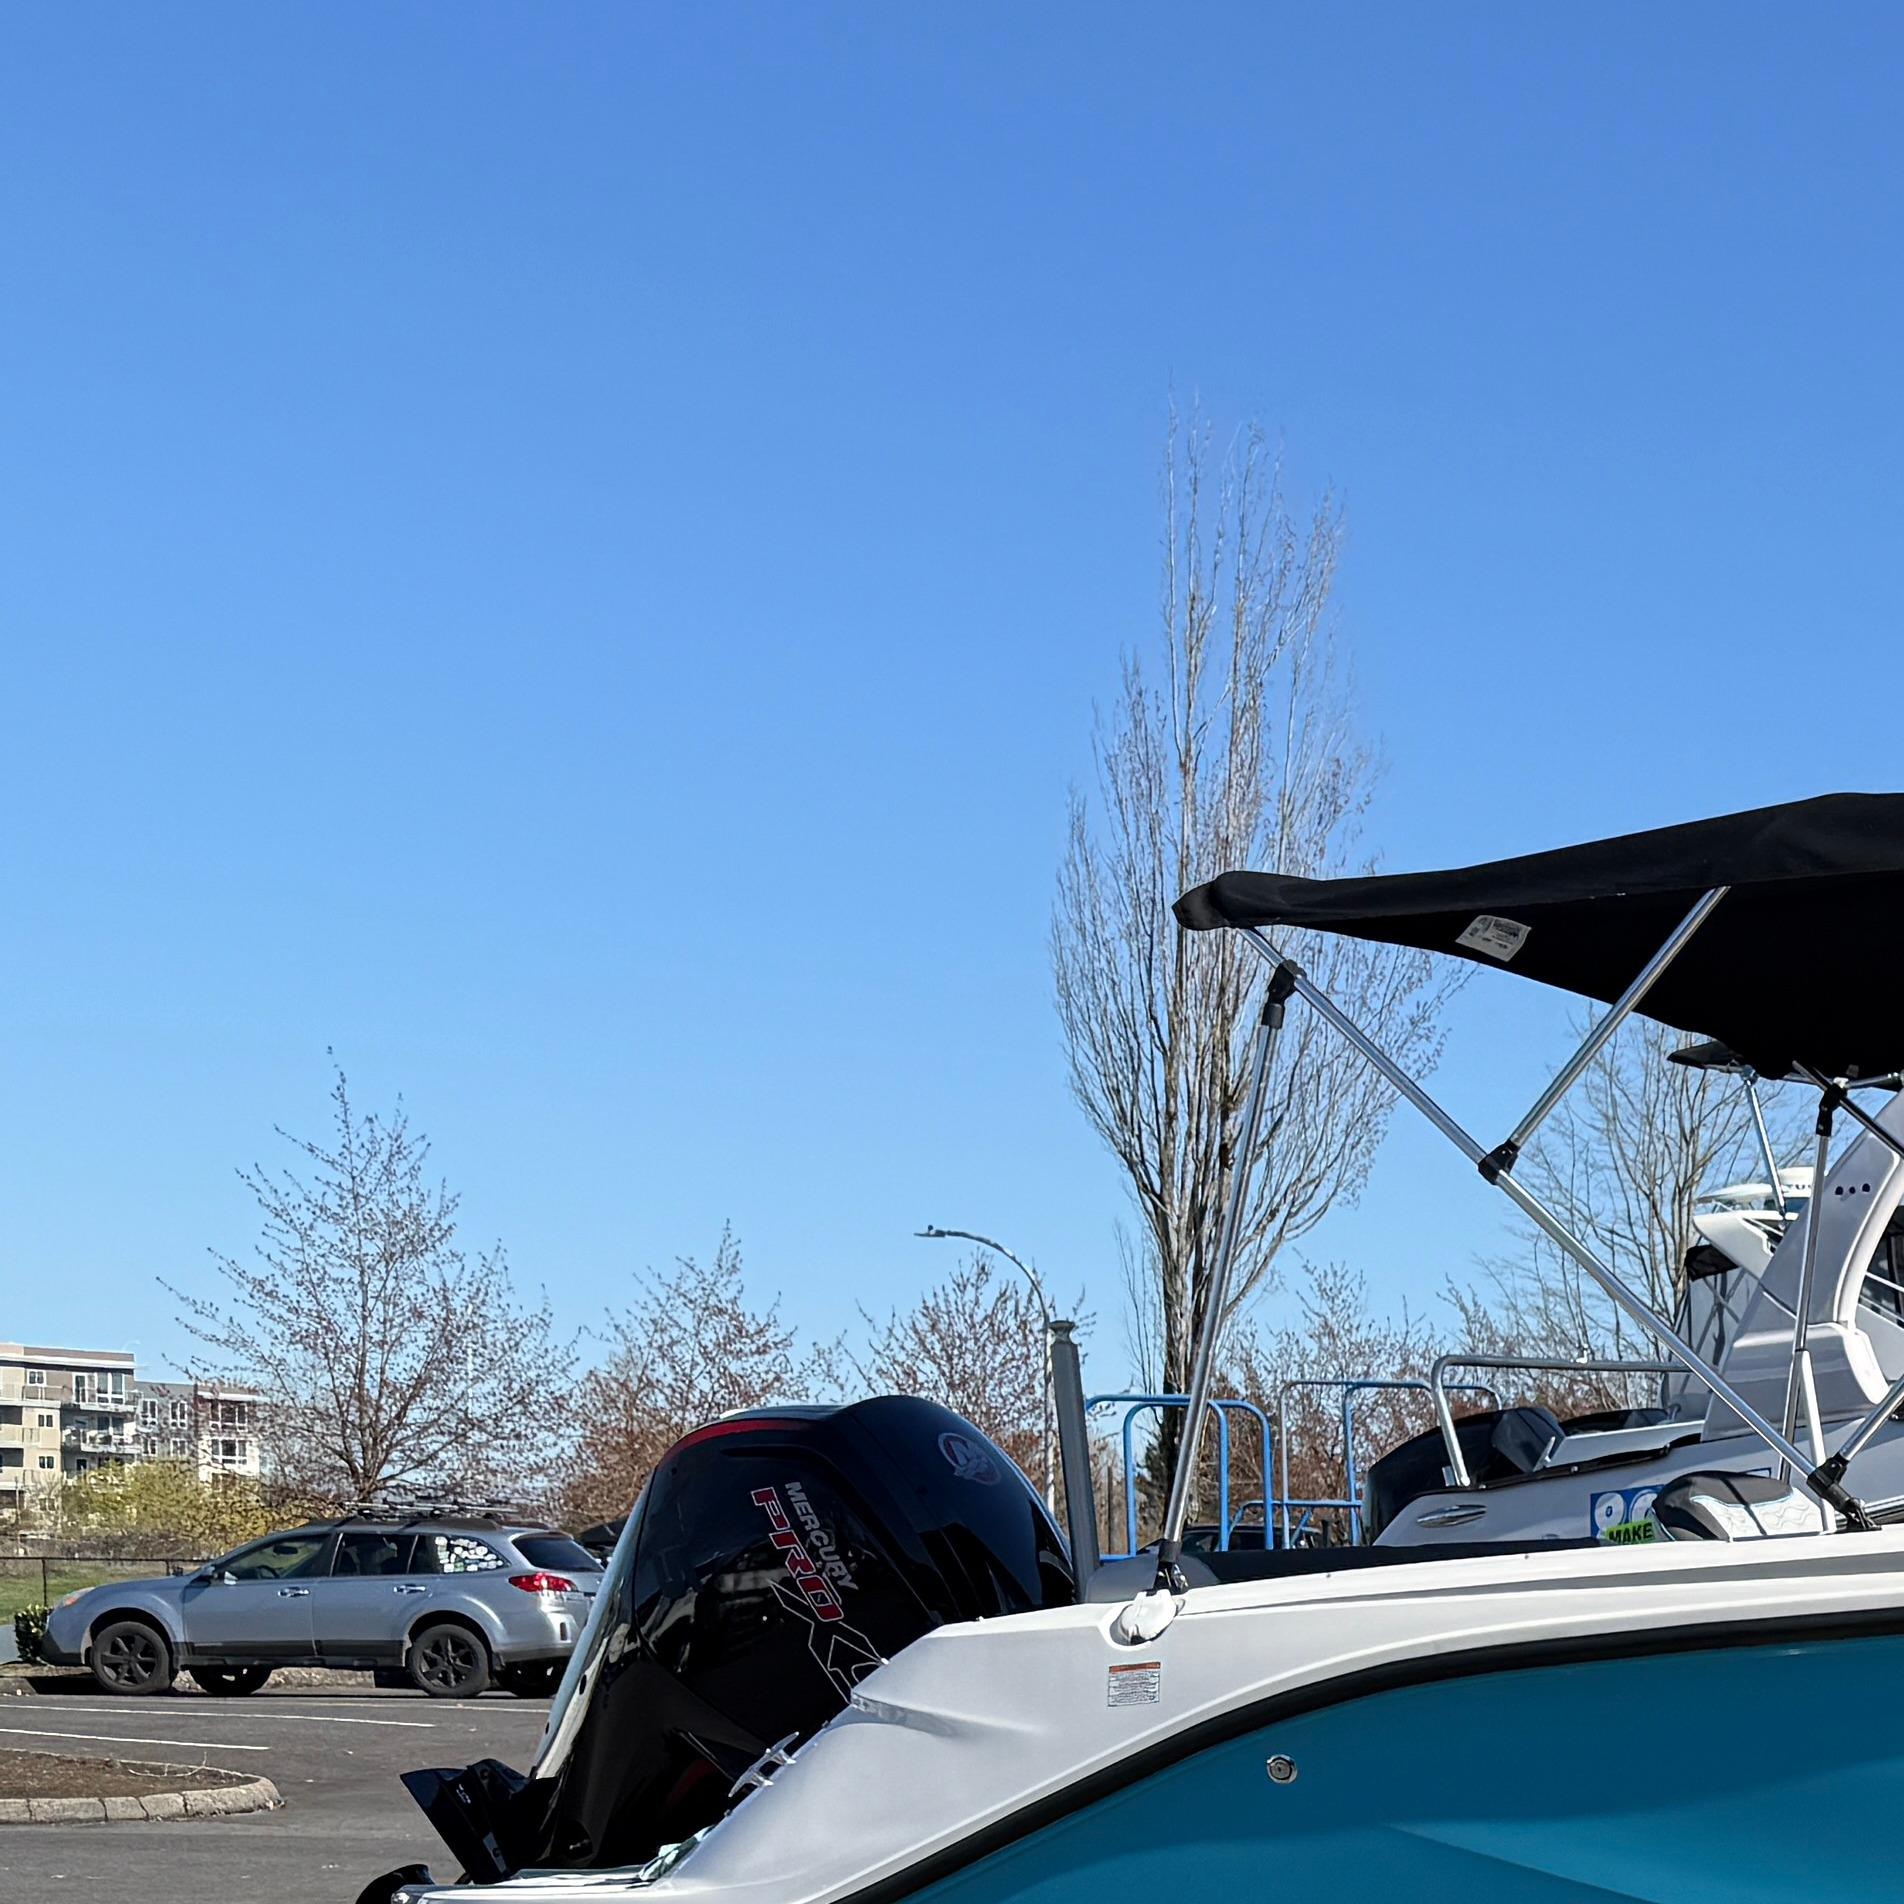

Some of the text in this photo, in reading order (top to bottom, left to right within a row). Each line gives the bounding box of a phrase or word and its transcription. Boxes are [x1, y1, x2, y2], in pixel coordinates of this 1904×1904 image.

[751, 1486, 844, 1622] PRO
[785, 1481, 859, 1591] MERCURY
[1608, 1521, 1653, 1544] MAKE
